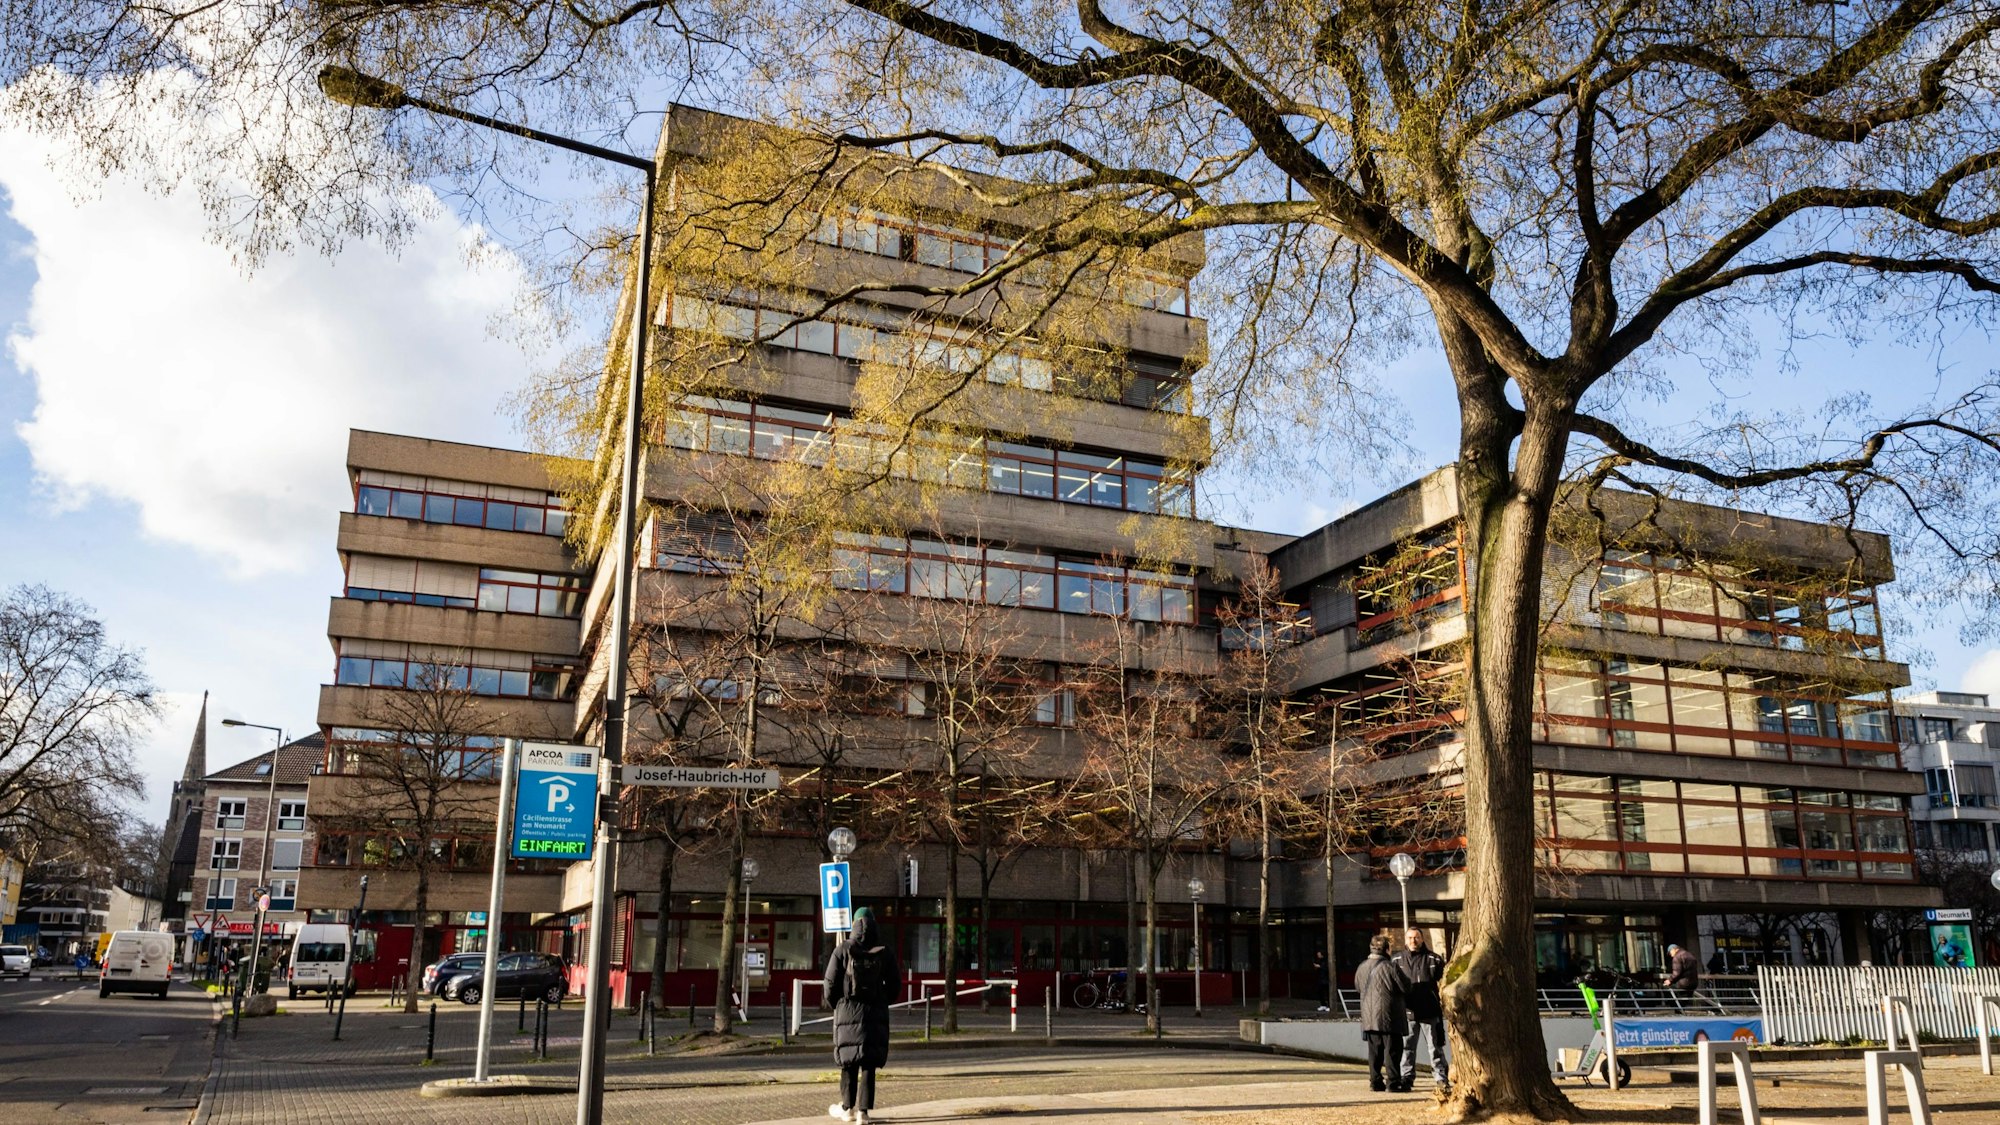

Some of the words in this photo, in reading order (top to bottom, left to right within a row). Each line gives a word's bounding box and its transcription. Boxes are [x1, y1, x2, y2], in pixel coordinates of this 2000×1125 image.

[529, 750, 563, 758] APCOA
[528, 758, 563, 766] PARKING
[635, 769, 766, 784] Josef-Haubrich-Hof
[547, 784, 569, 813] P
[522, 814, 572, 823] Cäcilienstrasse
[520, 840, 585, 853] EINFAHRT
[826, 870, 844, 907] P
[1927, 911, 1935, 920] U
[1615, 1029, 1639, 1044] Jetzt
[1641, 1028, 1690, 1045] günstiger
